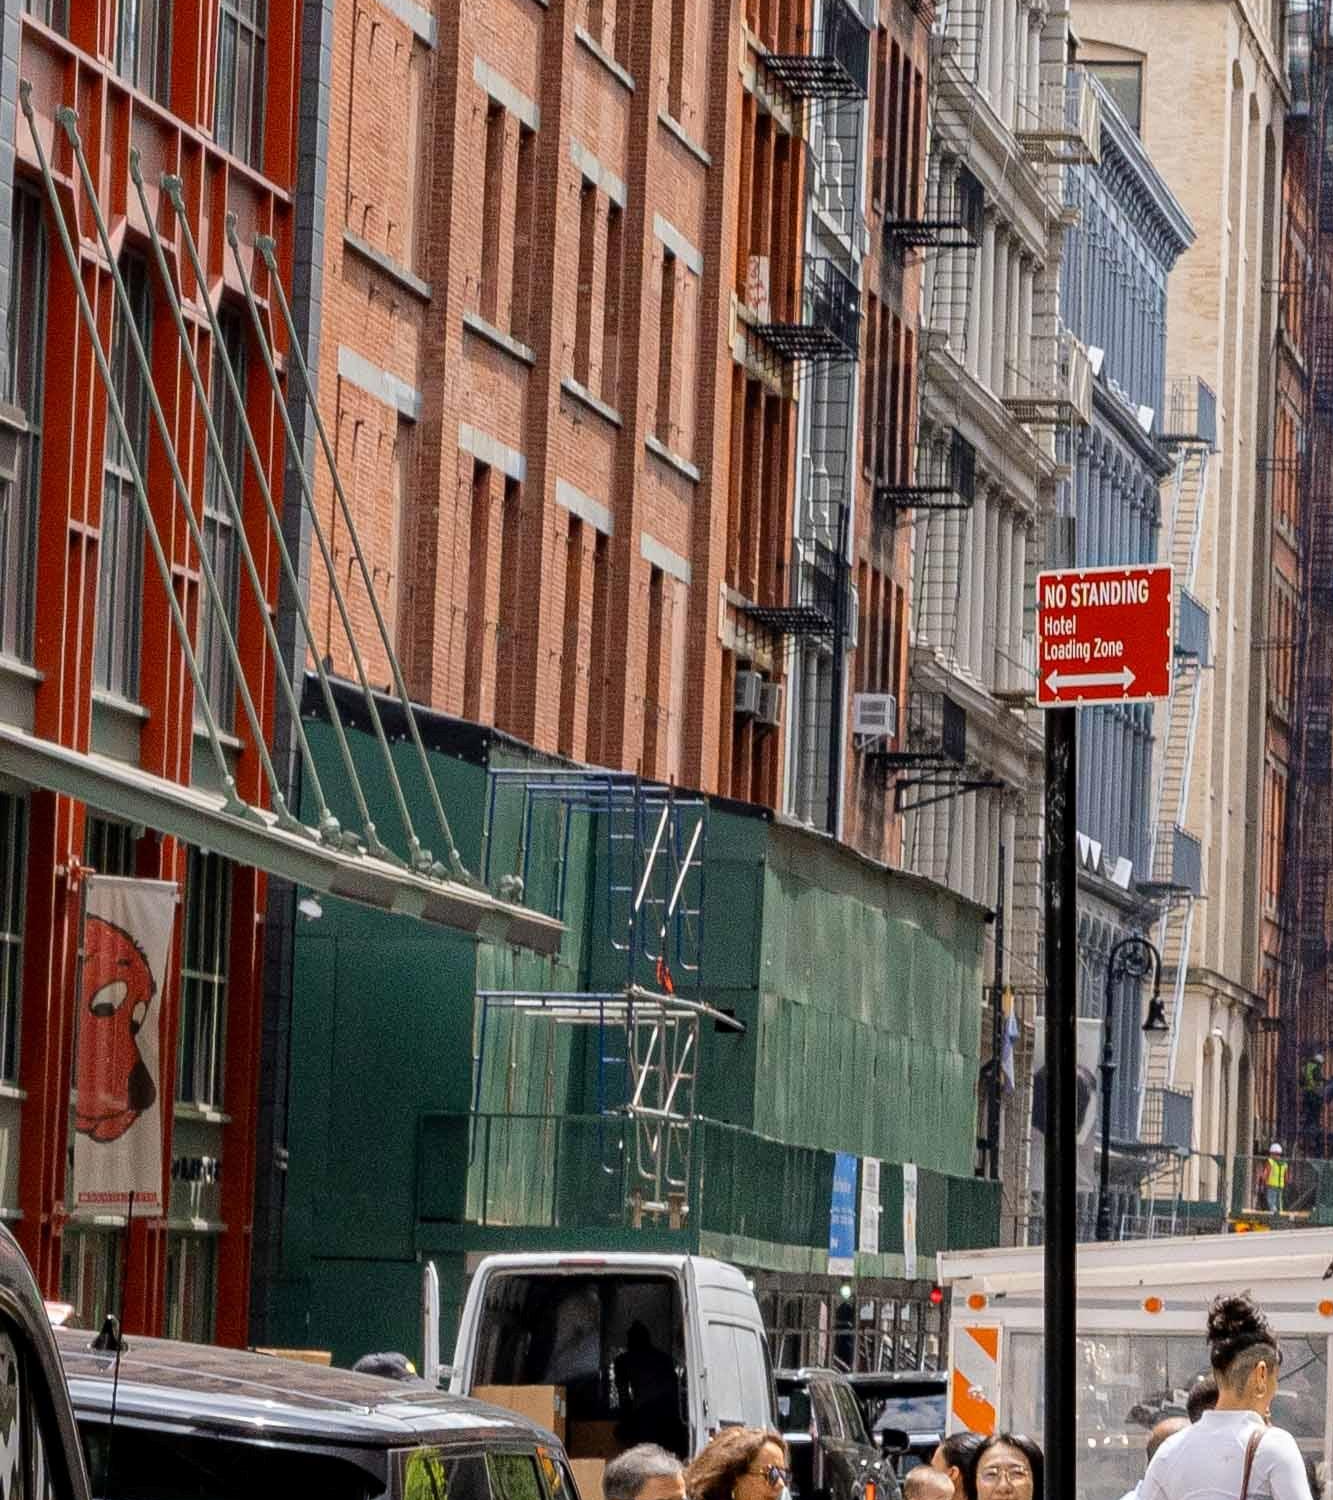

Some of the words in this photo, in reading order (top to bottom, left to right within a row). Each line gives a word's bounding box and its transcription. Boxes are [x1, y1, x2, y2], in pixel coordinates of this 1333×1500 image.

[1044, 584, 1067, 609] NO
[1071, 578, 1150, 606] STANDING
[1044, 615, 1077, 636] Hotel
[1044, 638, 1091, 662] Loading
[1093, 637, 1124, 658] Zone
